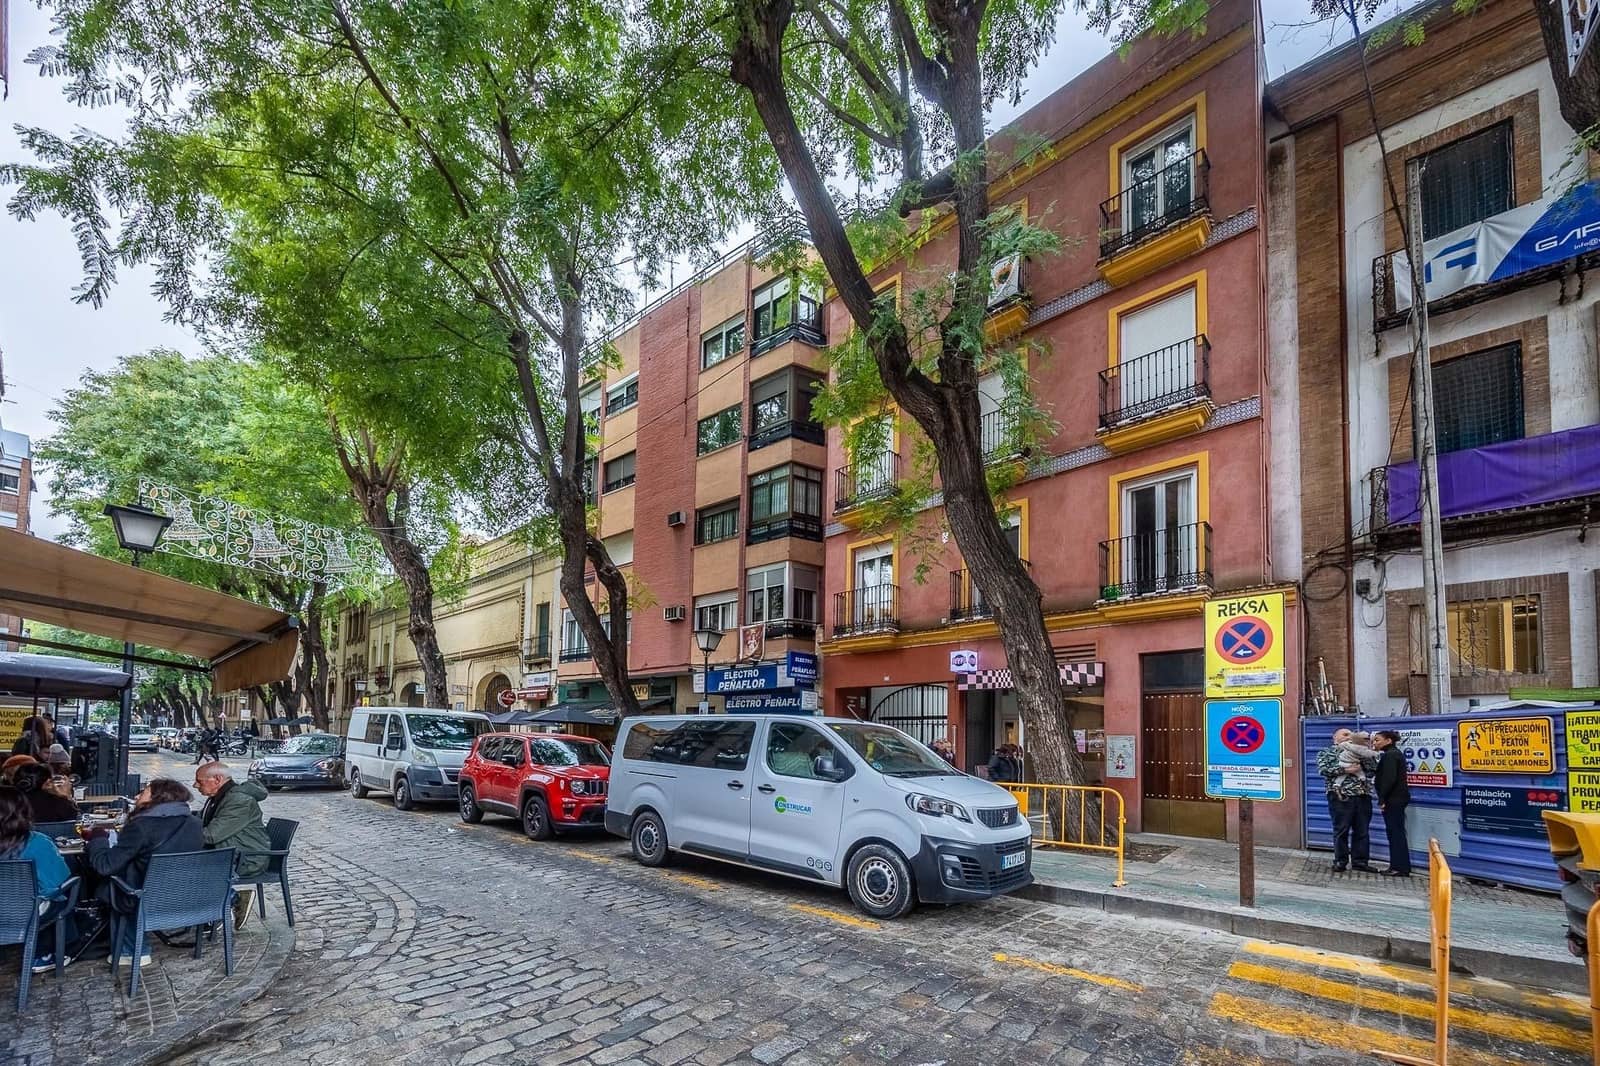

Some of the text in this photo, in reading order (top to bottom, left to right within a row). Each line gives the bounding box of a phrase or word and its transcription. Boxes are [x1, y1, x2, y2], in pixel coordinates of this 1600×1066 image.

[1217, 600, 1269, 617] REKSA
[724, 669, 759, 680] ELECTRO
[718, 678, 765, 691] PEÑAFLOR
[726, 699, 762, 709] ELECTRO
[1508, 759, 1549, 767] CAMIONES
[1465, 789, 1511, 799] Instalación
[1465, 798, 1507, 807] protegida
[1528, 800, 1558, 808] Securitas
